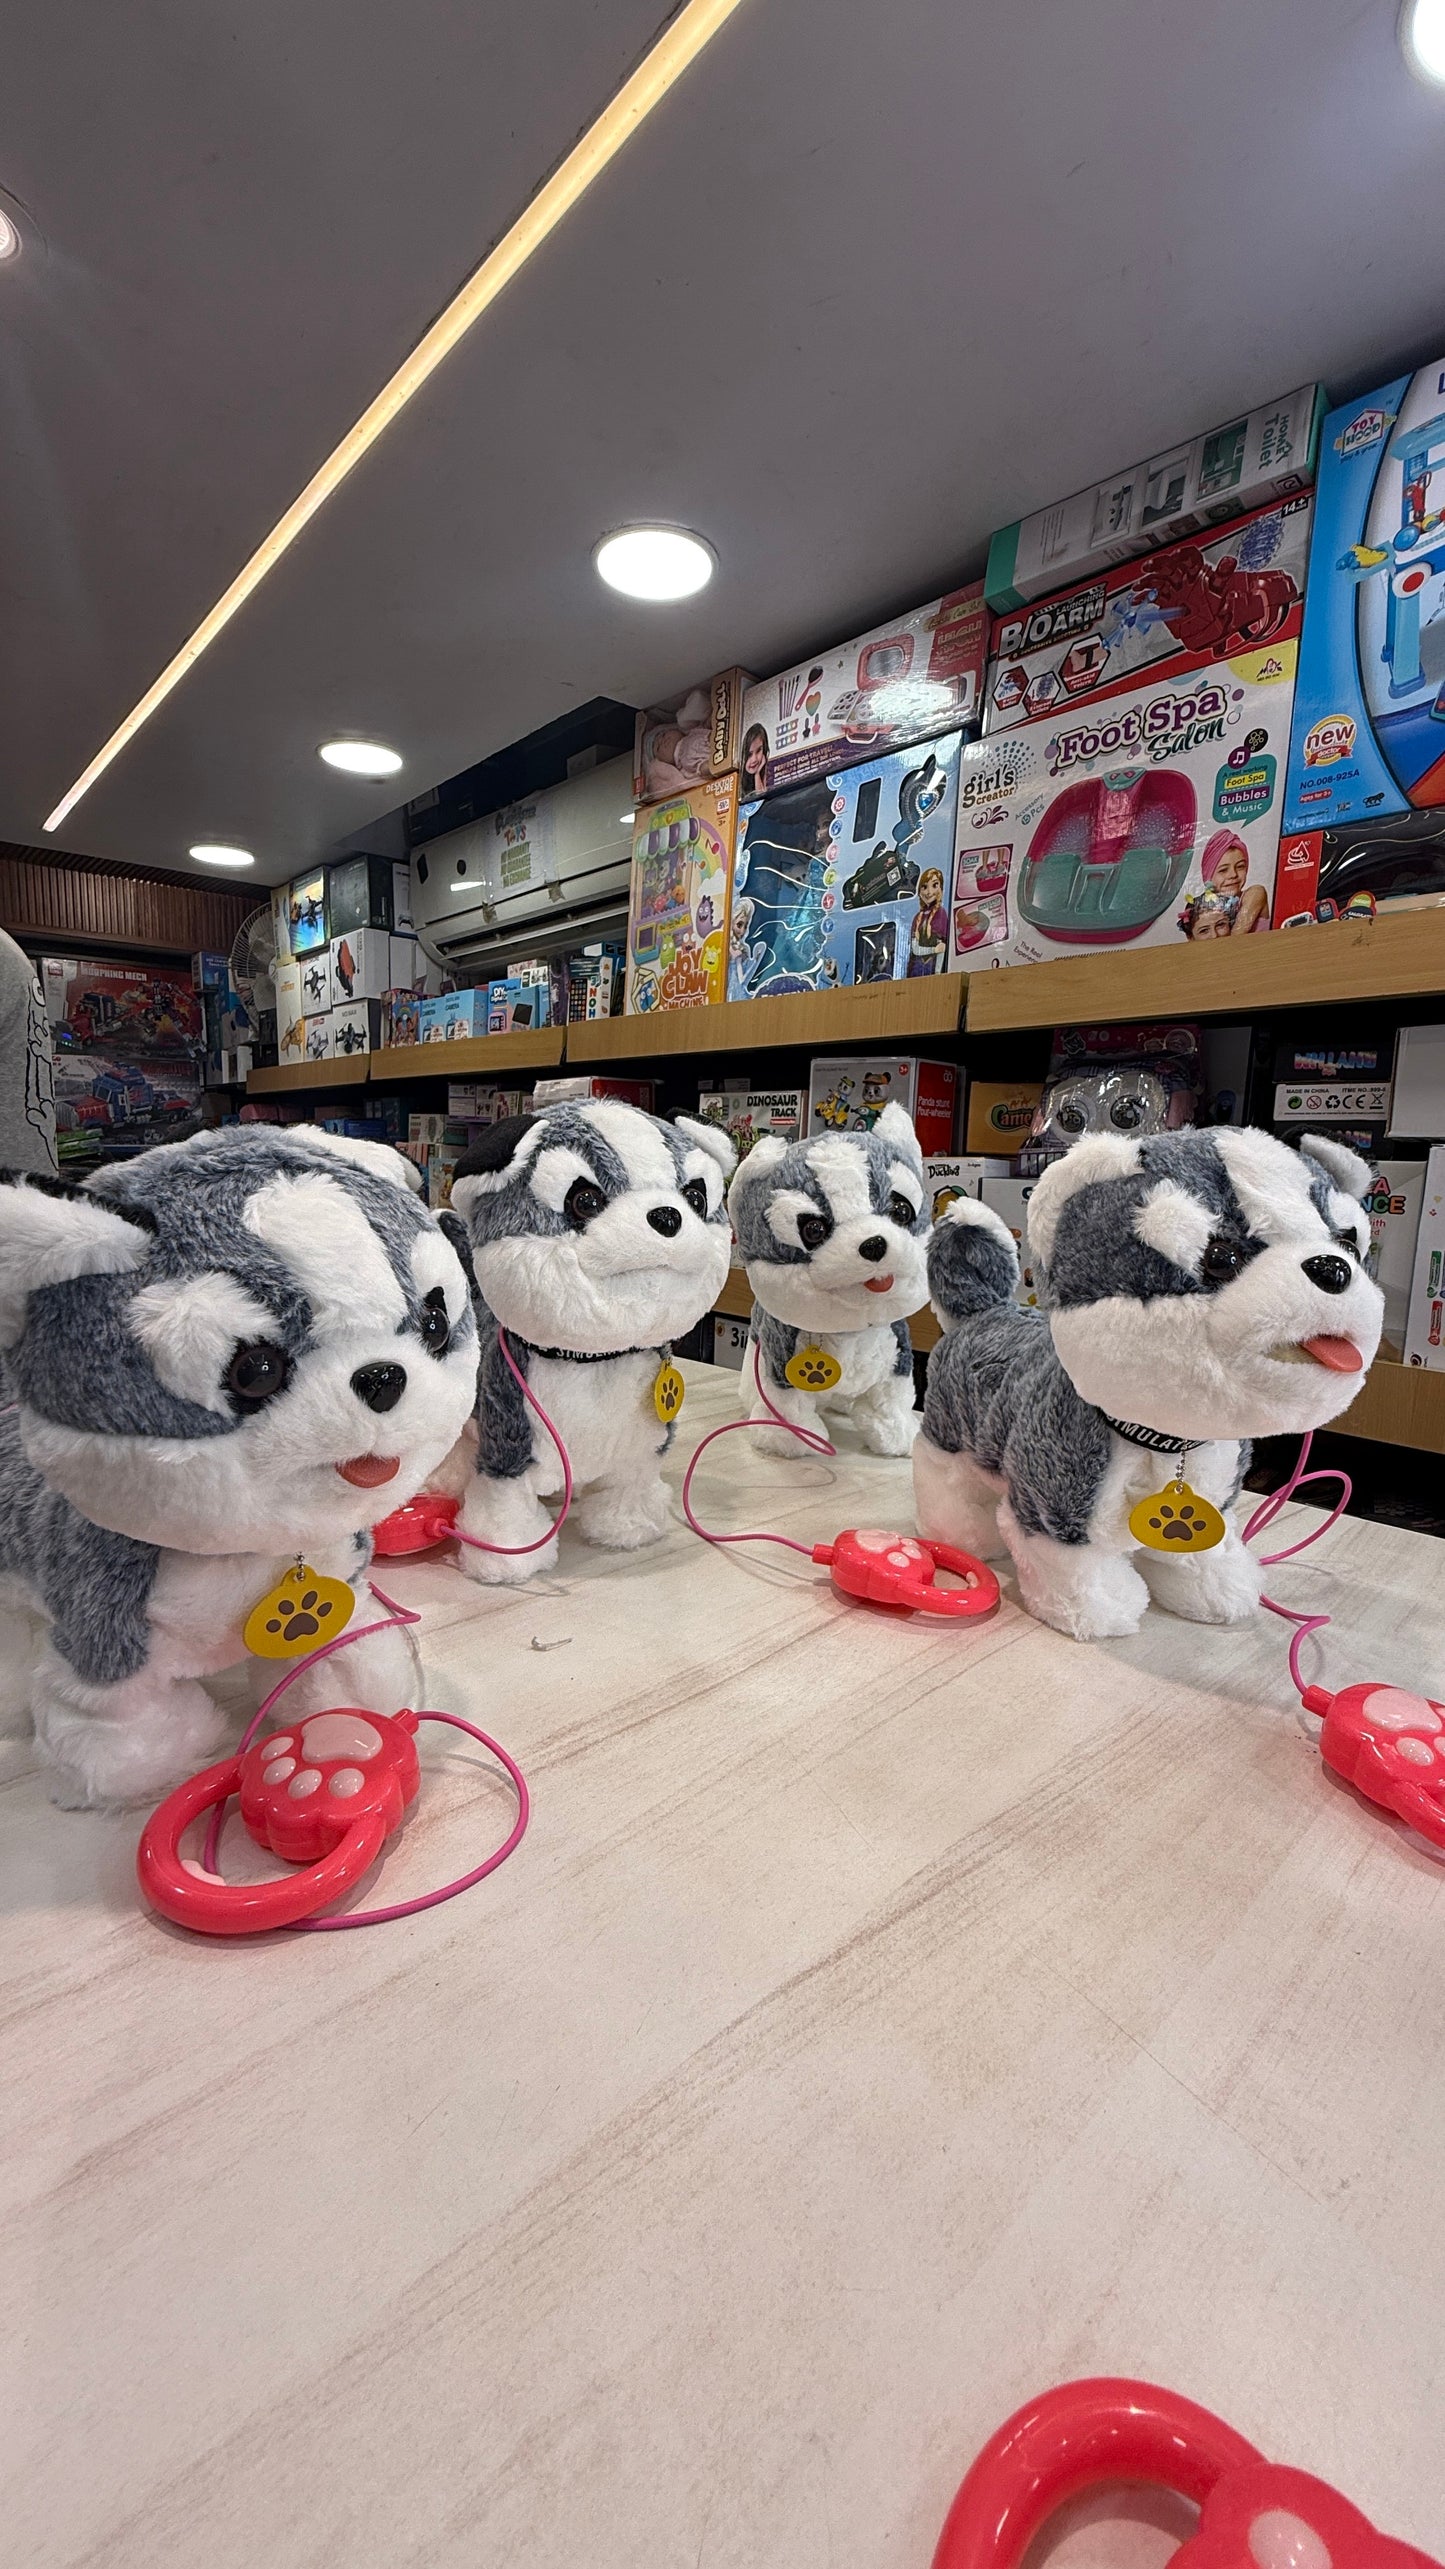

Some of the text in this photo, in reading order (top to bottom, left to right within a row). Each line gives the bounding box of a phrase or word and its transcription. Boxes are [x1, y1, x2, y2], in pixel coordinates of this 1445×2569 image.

[1351, 414, 1377, 432] TOY
[1258, 413, 1280, 470] Toilet
[1283, 497, 1306, 514] 14+
[1056, 590, 1105, 615] LAUNCHING
[1058, 690, 1224, 766] Foot Spa
[1306, 723, 1355, 748] new
[1147, 717, 1227, 761] Salon
[1317, 746, 1341, 758] doctor
[1243, 765, 1268, 774] working
[706, 777, 734, 794] DESKTOP
[961, 764, 1016, 809] girl's
[1226, 774, 1264, 787] Foot Spa
[1299, 769, 1360, 790] NO.008-925A
[715, 784, 733, 796] GAME
[975, 786, 1016, 806] creator
[1220, 790, 1267, 806] Bubbles
[1015, 792, 1044, 821] Accessory
[1031, 804, 1045, 820] Pcs
[1221, 803, 1263, 816] & Music
[1020, 941, 1043, 959] The Real
[669, 947, 703, 976] JOY
[81, 966, 147, 982] MORPHING MECH
[661, 969, 709, 1001] CLAW
[747, 1094, 798, 1107] DINOSAUR
[918, 1095, 935, 1107] Panda
[770, 1107, 797, 1118] TRACK
